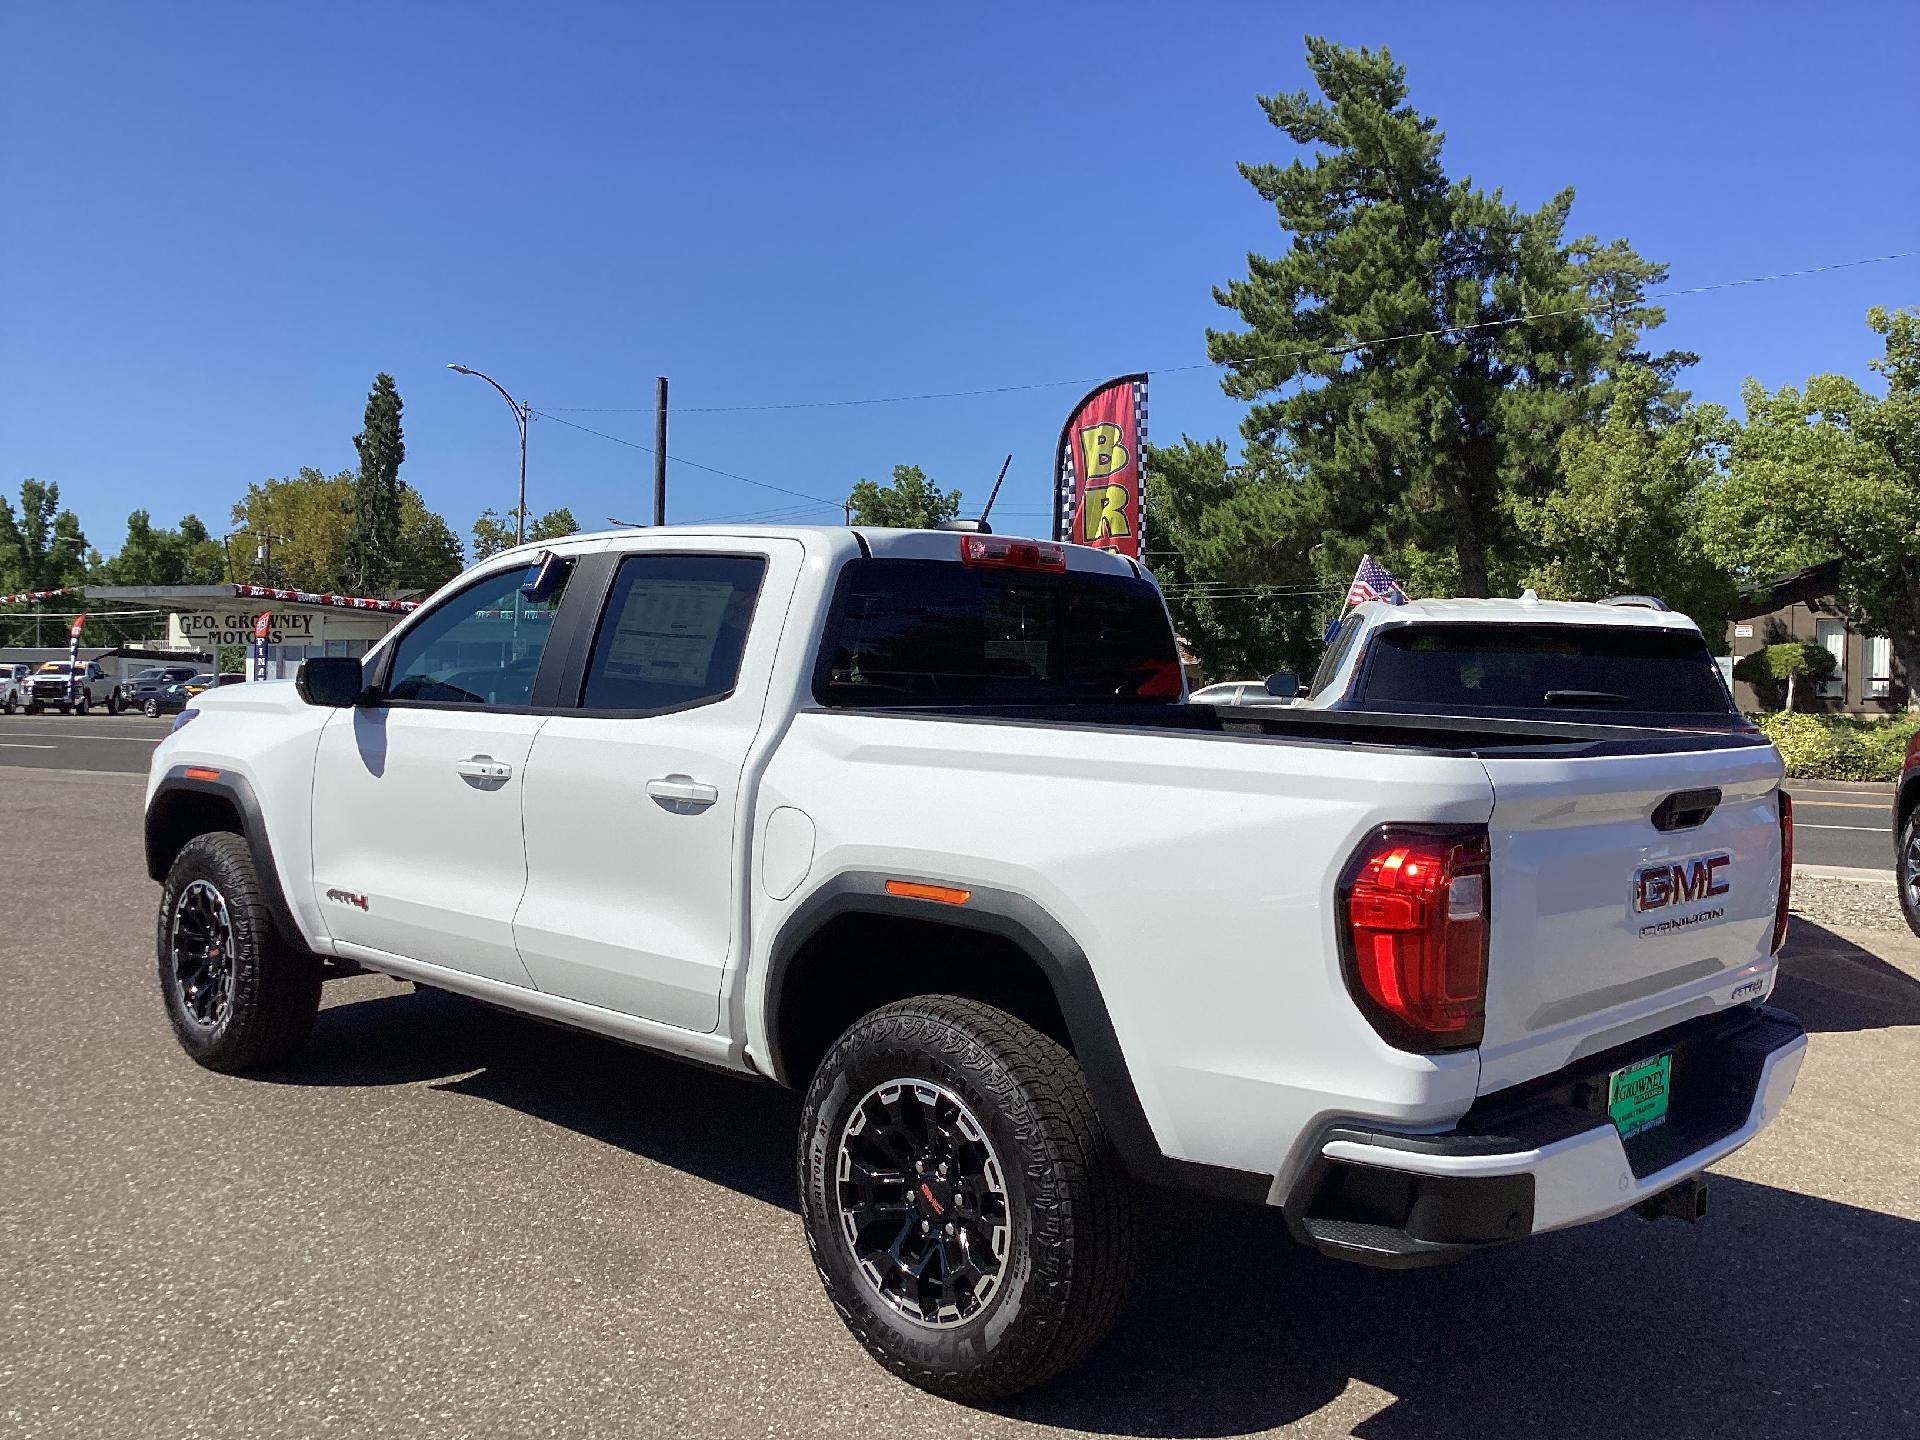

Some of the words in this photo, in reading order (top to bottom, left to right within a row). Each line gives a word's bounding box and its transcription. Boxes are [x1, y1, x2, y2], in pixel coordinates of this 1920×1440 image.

[1079, 422, 1132, 554] BR
[180, 615, 219, 634] GEO.
[208, 631, 282, 645] MOTOS
[1634, 855, 1731, 912] GMC
[1640, 908, 1724, 937] CANYON
